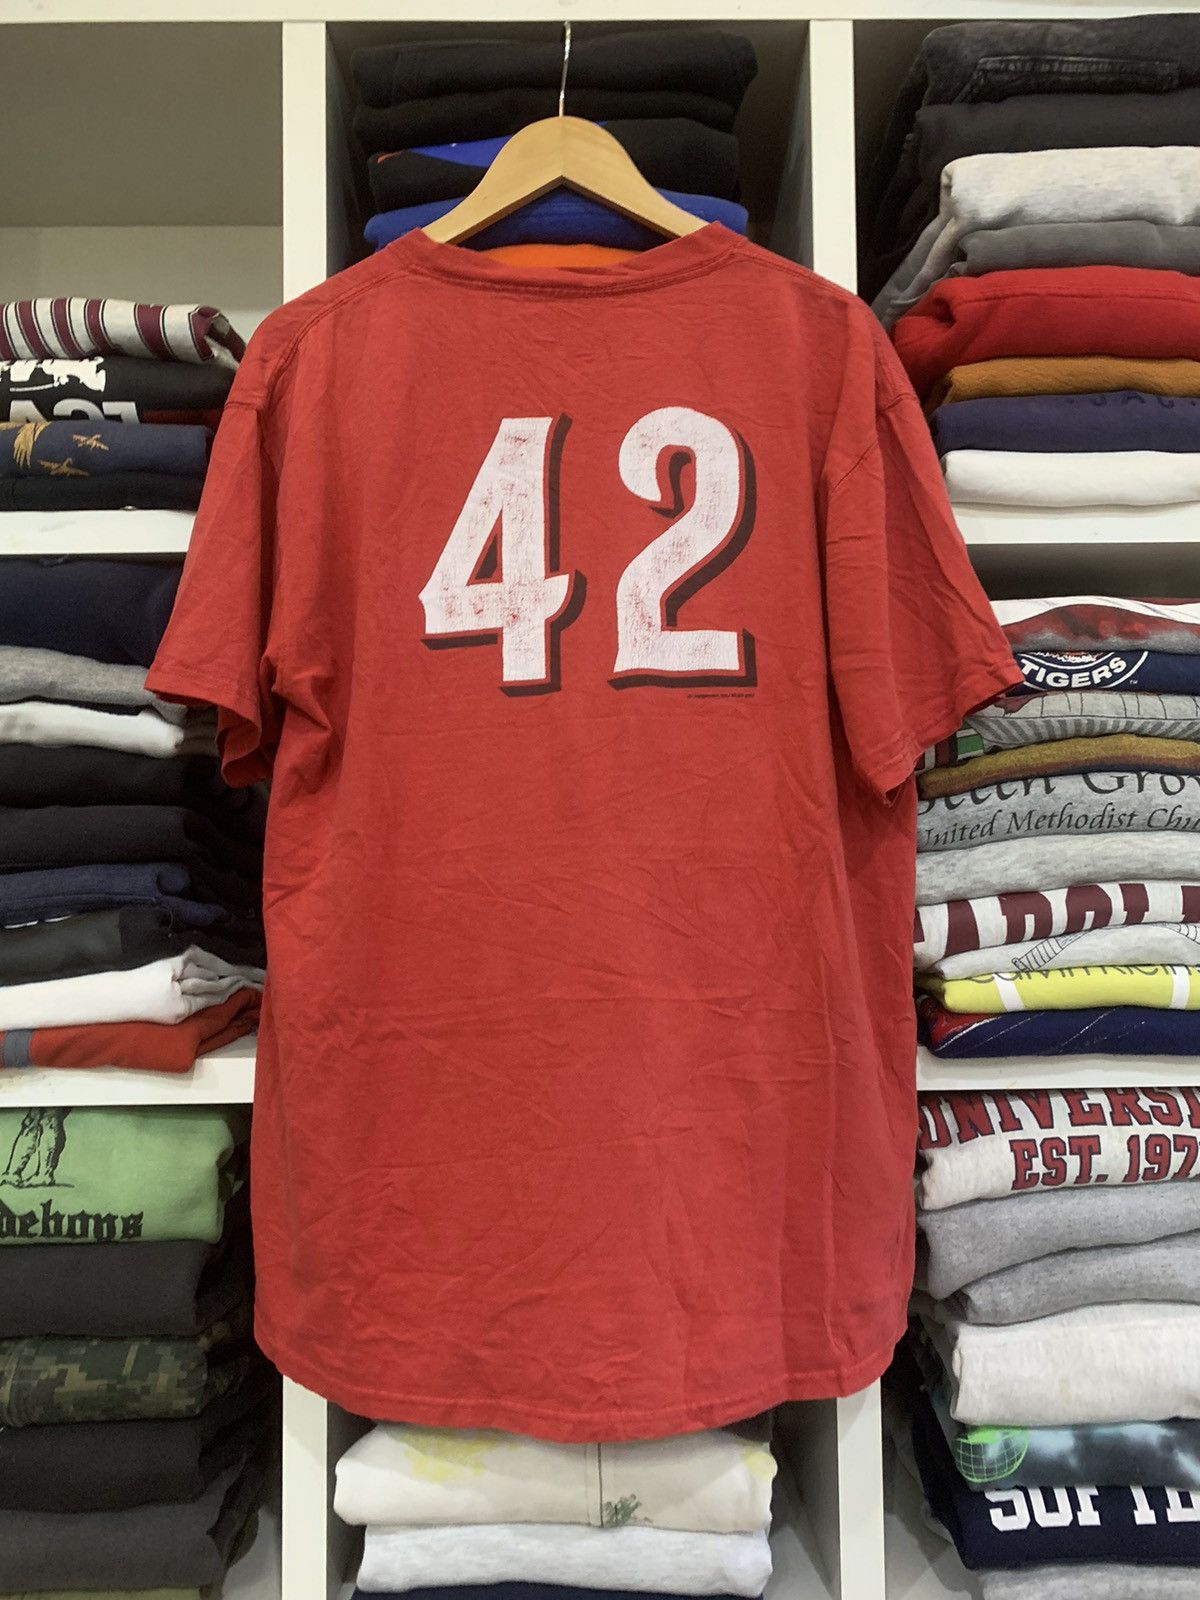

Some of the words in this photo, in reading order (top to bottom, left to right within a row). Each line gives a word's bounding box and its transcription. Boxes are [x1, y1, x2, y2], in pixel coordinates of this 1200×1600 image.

[418, 406, 757, 697] 42
[1019, 656, 1128, 688] TIGERS
[1006, 802, 1139, 834] Methodist
[1009, 1134, 1109, 1191] EST.
